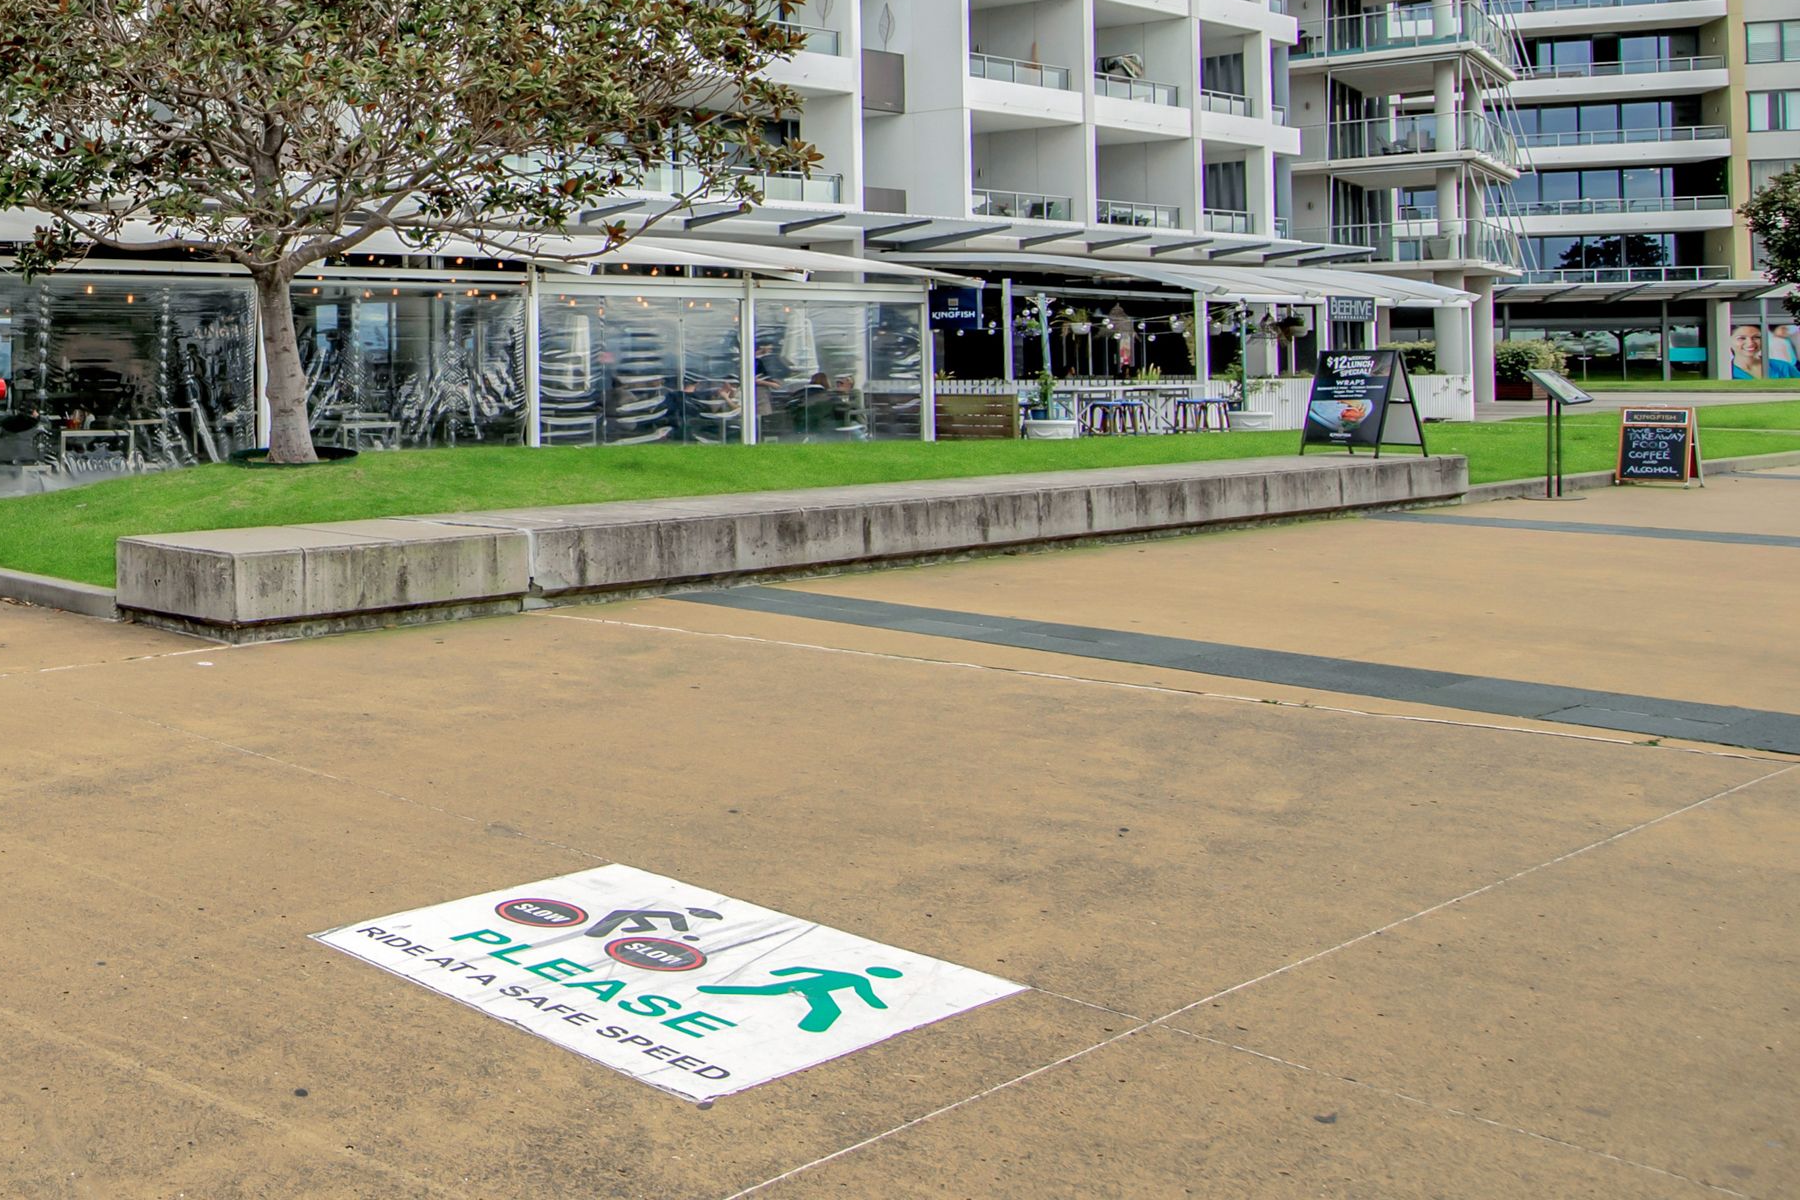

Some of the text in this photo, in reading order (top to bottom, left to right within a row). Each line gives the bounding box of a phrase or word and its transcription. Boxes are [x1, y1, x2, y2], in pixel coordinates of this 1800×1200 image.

[1330, 298, 1373, 316] BEEHIVE
[932, 311, 975, 319] KINGFISH
[1326, 355, 1348, 369] $12
[1347, 360, 1375, 369] LUNCH
[1628, 432, 1685, 442] TAKEAWAY
[1628, 450, 1671, 460] COFFEE
[1626, 465, 1678, 474] ALCOHOL
[513, 902, 572, 923] SLOW
[624, 942, 684, 965] SLOW
[448, 928, 739, 1039] PLEASE
[356, 926, 731, 1080] RIDE AT A SAFE SPEED
